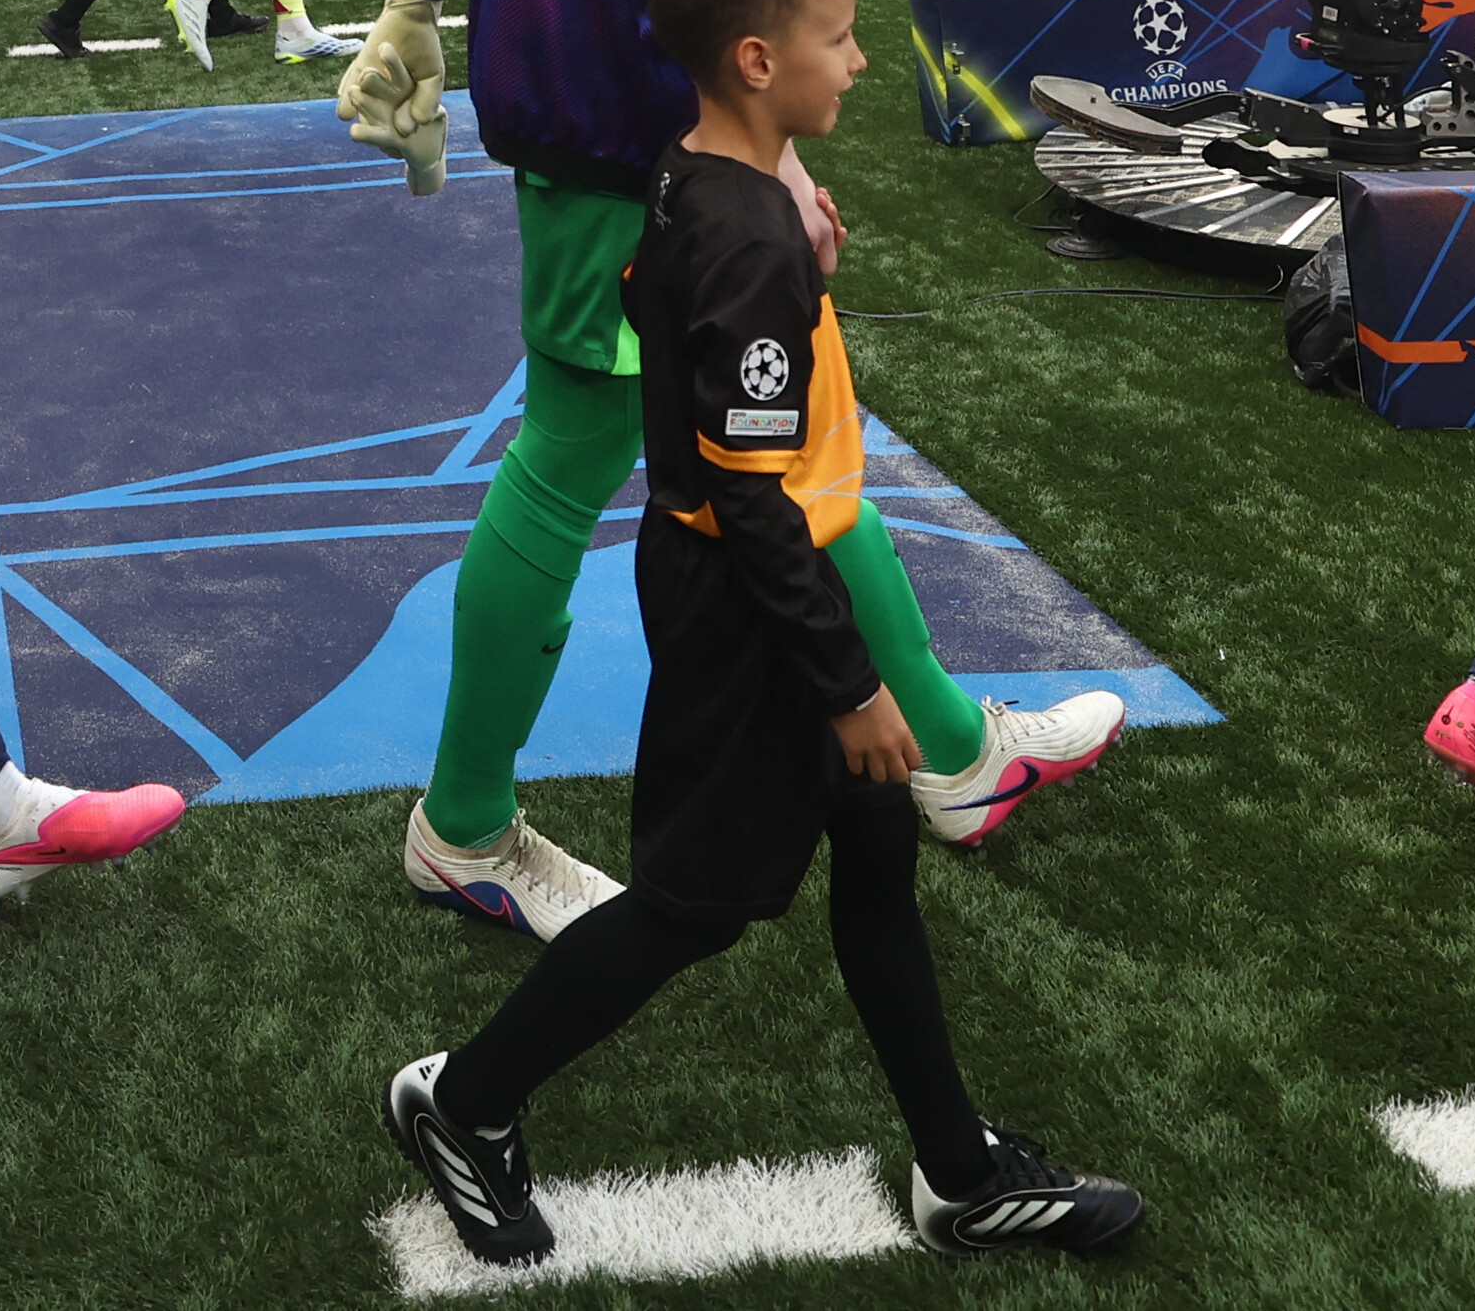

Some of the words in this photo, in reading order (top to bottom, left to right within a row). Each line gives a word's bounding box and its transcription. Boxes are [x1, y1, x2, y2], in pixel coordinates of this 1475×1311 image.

[1147, 63, 1184, 79] UEFA
[1111, 79, 1229, 104] CHAMPIONS
[730, 418, 796, 429] FOUNDATION
